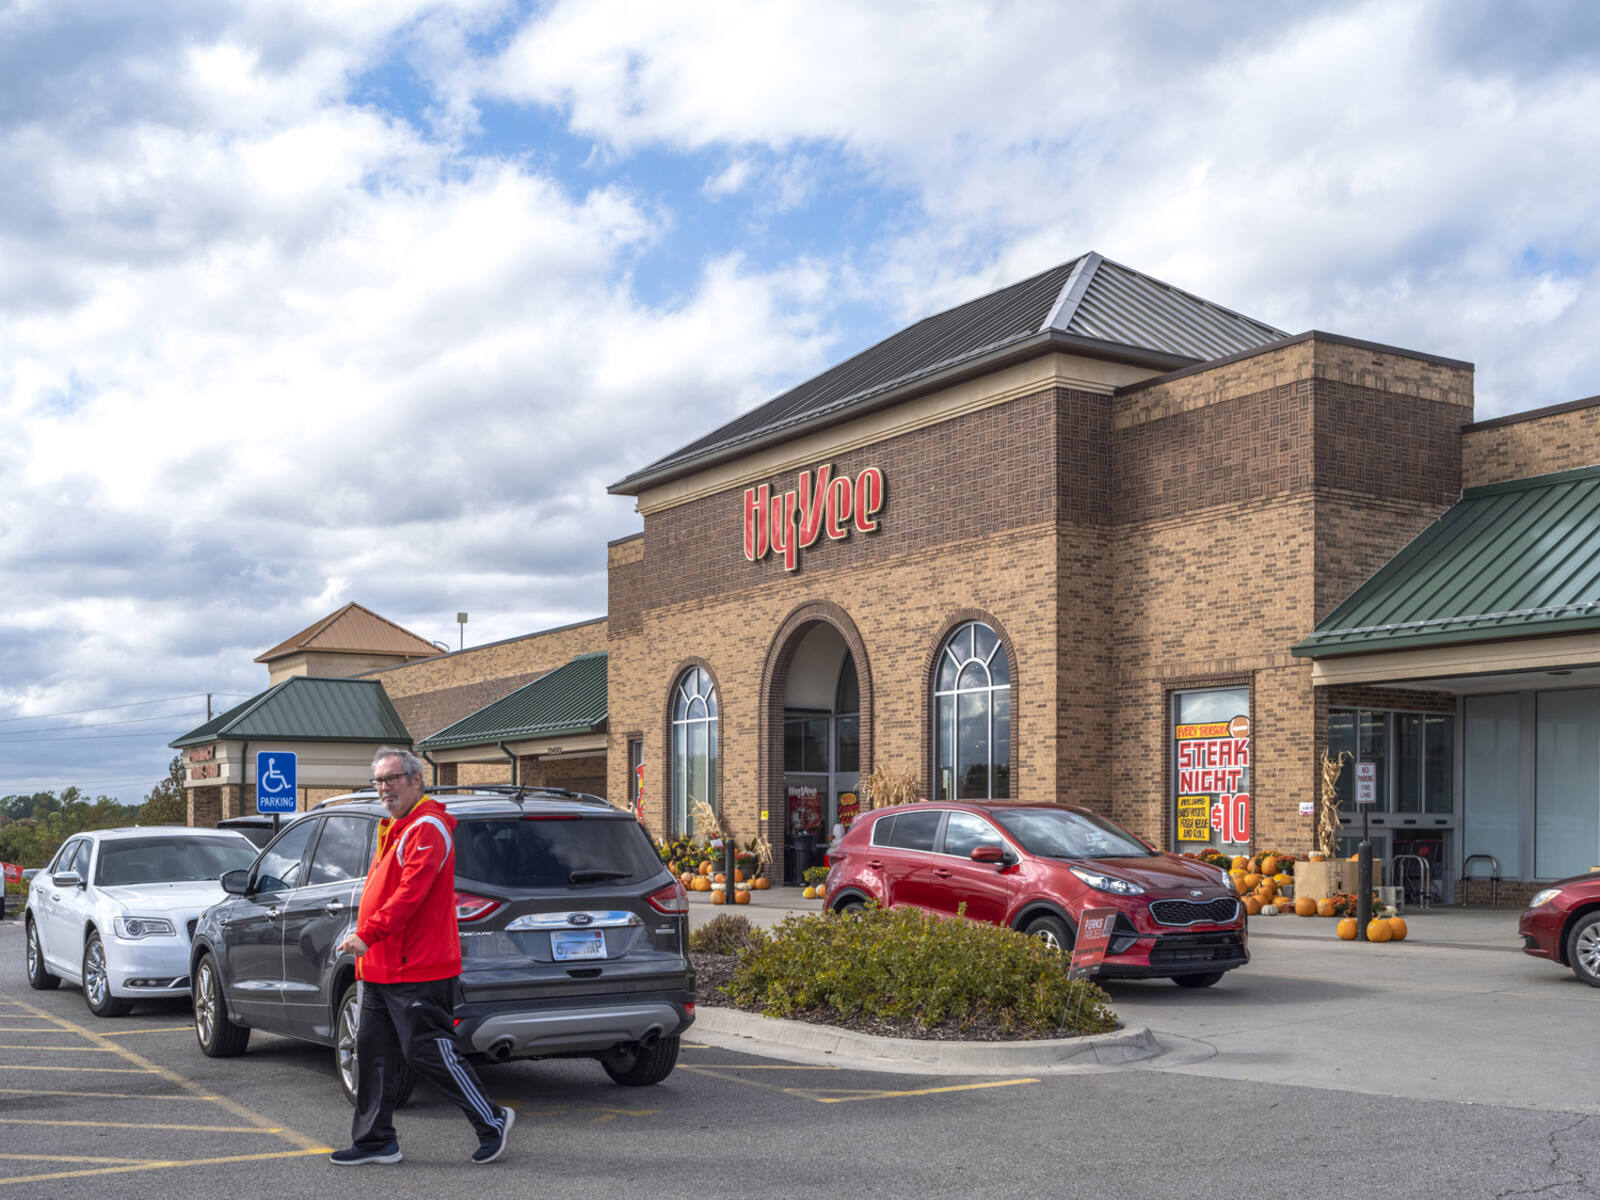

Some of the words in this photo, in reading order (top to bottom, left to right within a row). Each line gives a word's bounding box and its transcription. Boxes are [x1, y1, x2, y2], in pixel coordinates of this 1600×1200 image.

[1177, 726, 1197, 739] EVERY
[1199, 724, 1228, 737] THURSDAY
[1179, 739, 1249, 769] STEAK
[1179, 768, 1243, 794] NIGHT
[260, 796, 294, 807] PARKING
[1211, 793, 1249, 843] $10
